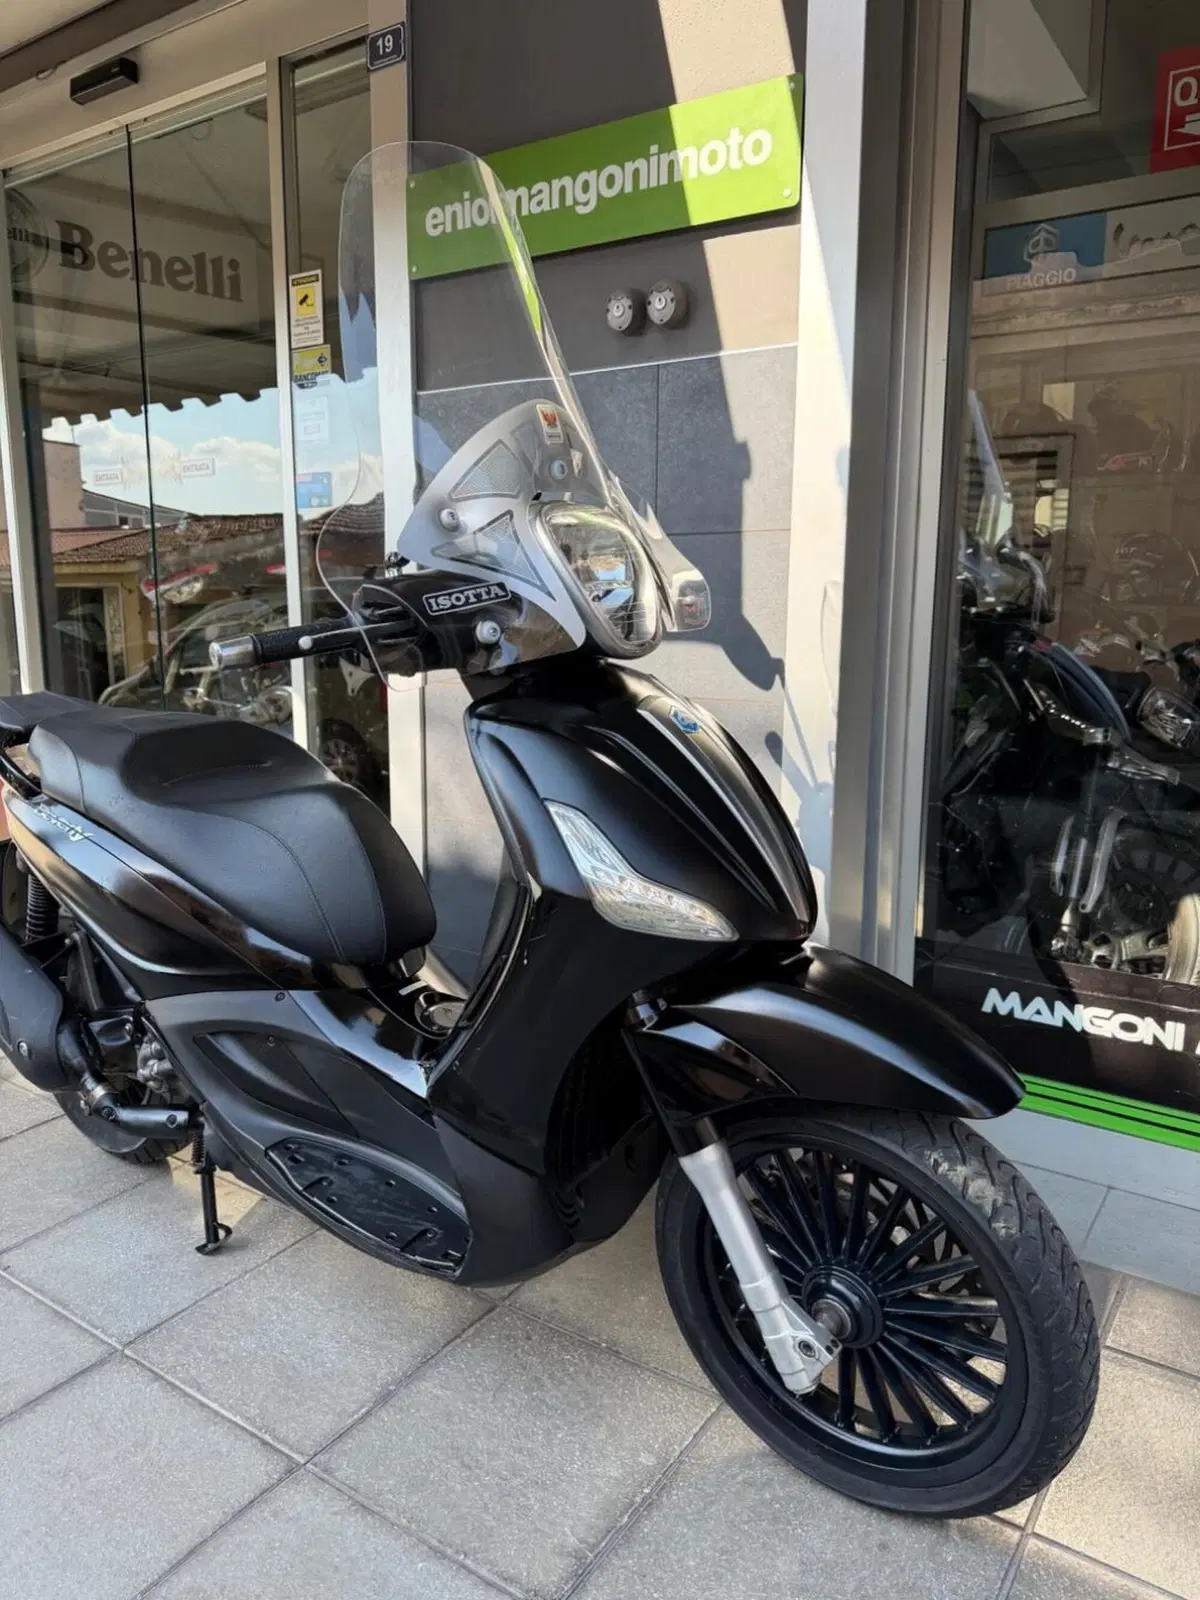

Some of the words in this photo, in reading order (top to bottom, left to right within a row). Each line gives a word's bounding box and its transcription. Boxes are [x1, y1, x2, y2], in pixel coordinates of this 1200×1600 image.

[376, 34, 393, 55] 19
[55, 219, 244, 302] Benelli
[1007, 267, 1077, 291] PIAGGIO
[428, 584, 505, 611] ISOTTA
[981, 987, 1186, 1052] MANGONI
